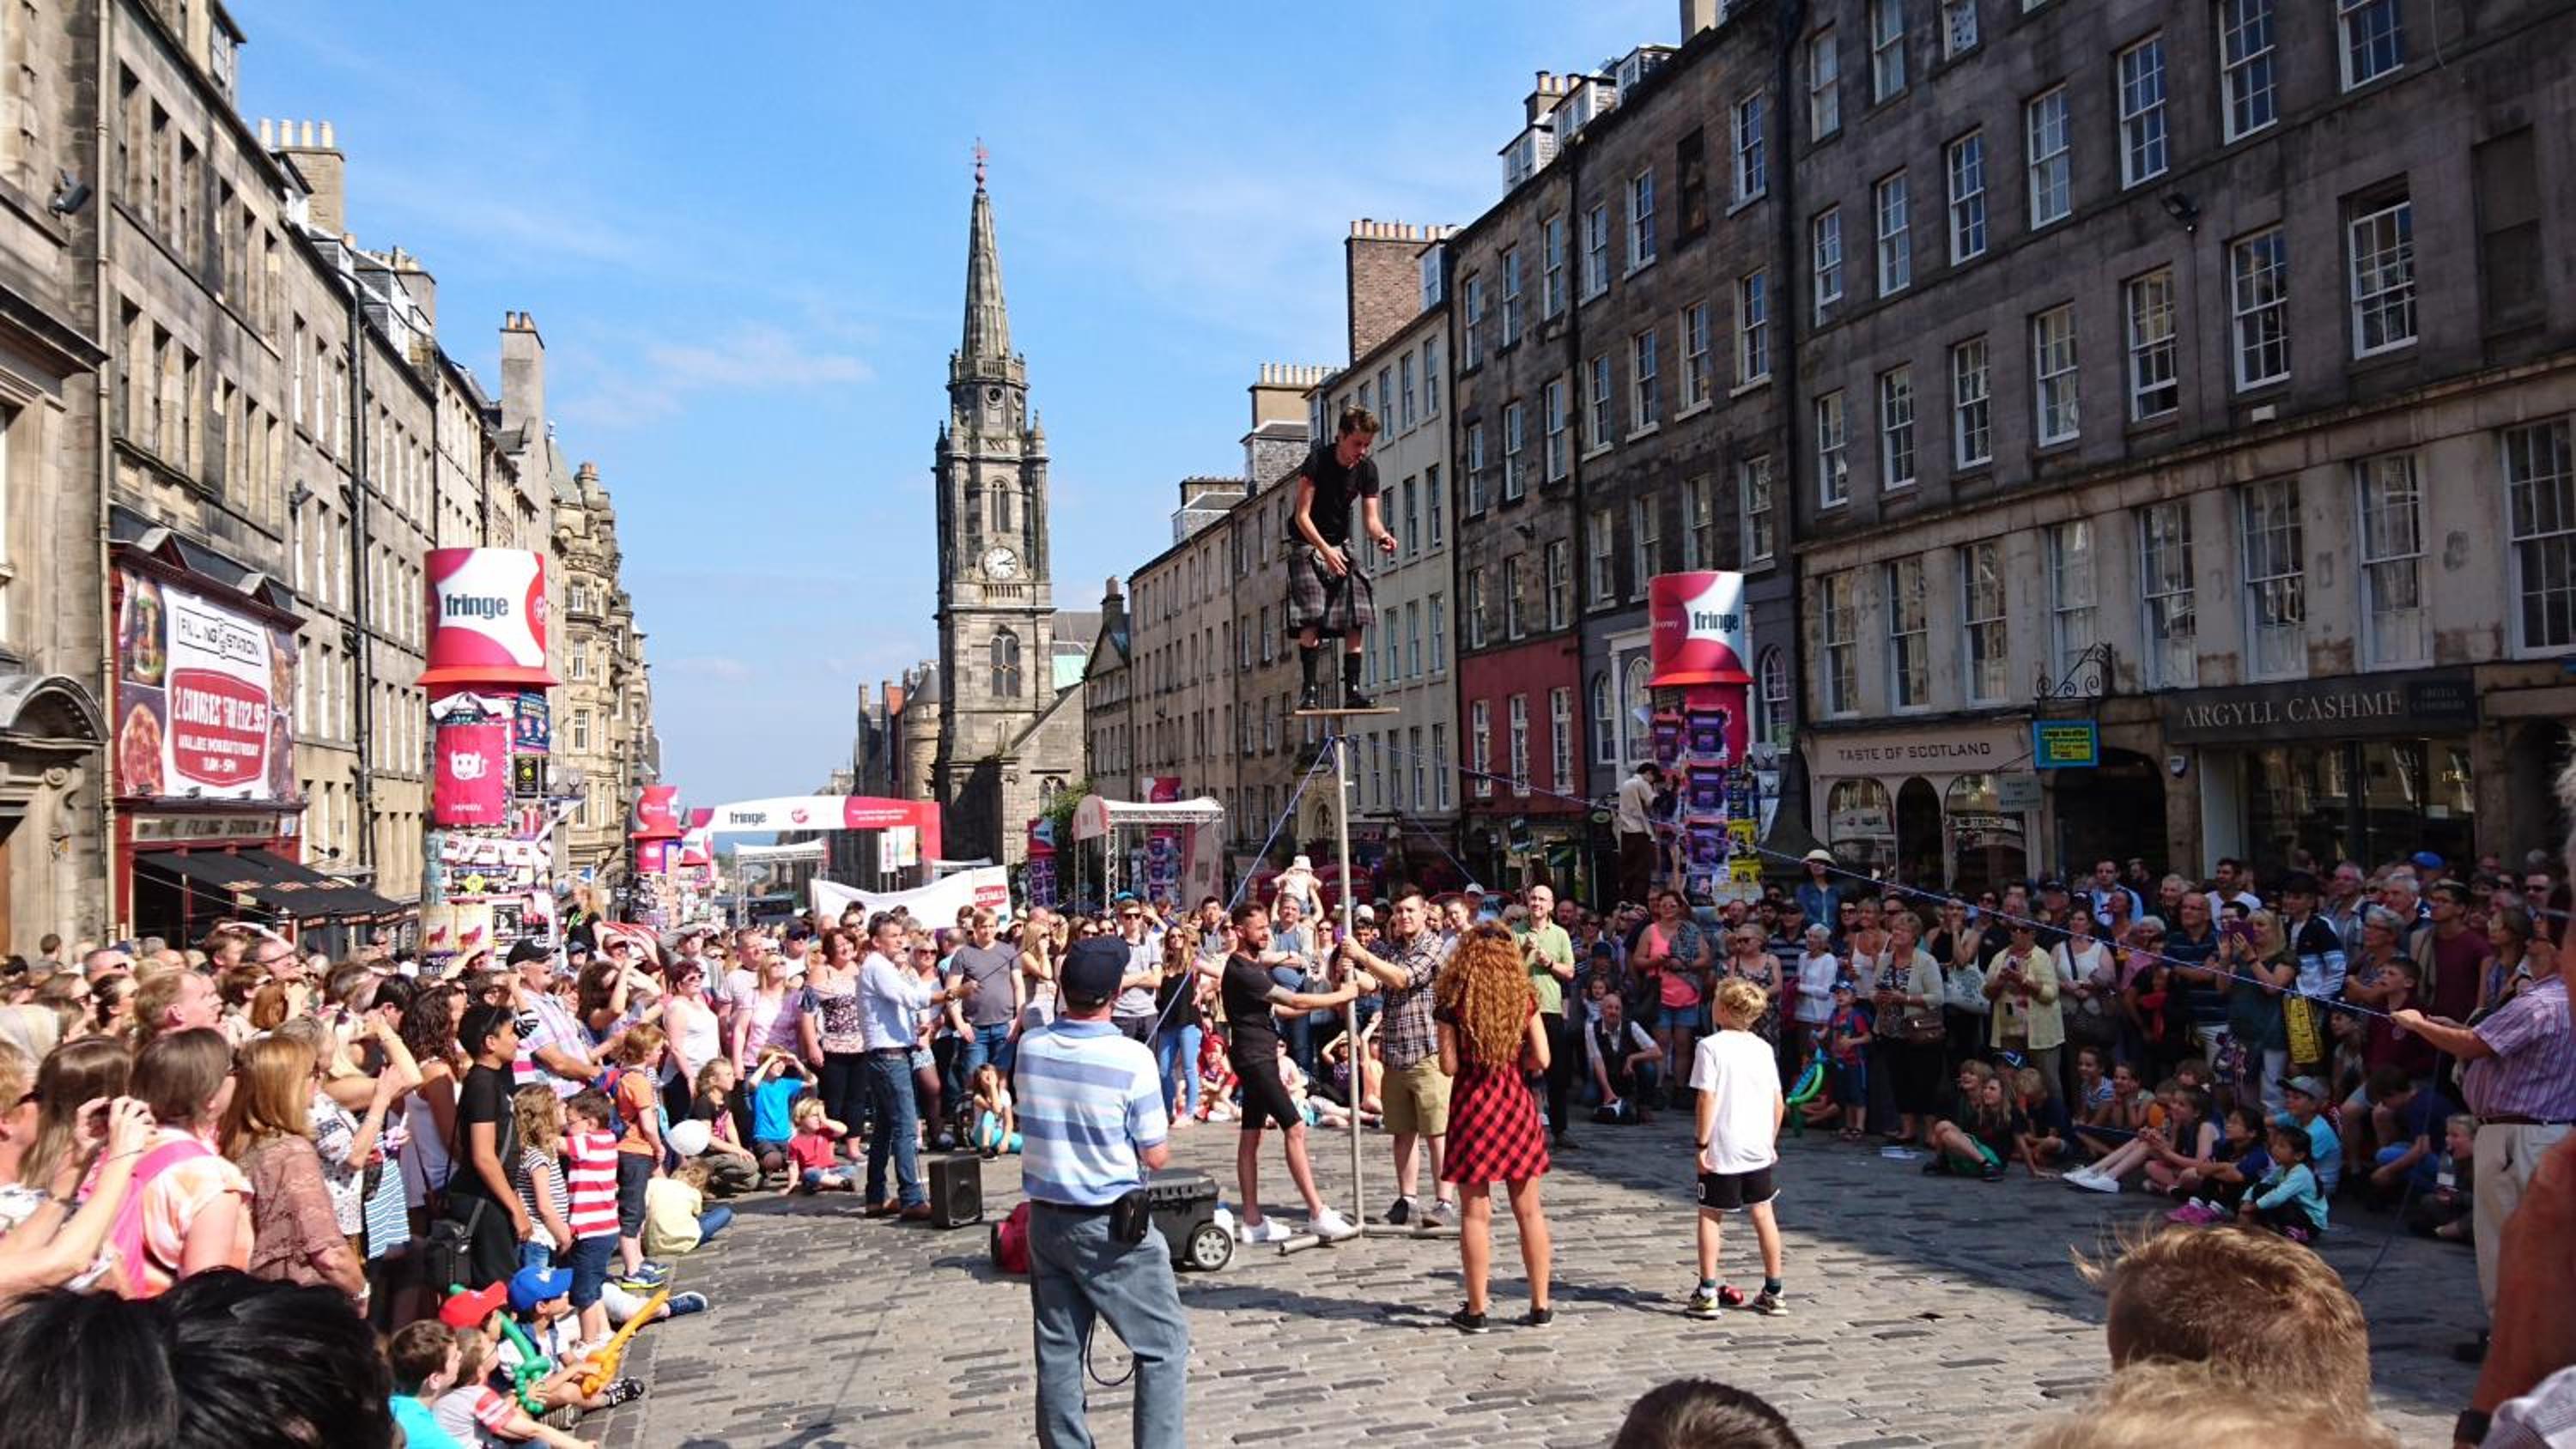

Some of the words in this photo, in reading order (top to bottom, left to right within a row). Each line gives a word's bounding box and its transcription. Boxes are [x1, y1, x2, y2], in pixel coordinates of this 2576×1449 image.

[446, 593, 508, 620] fringe
[1694, 610, 1739, 634] fringe
[174, 686, 183, 720] 2
[2184, 700, 2280, 727] ARGYLL
[1838, 748, 1880, 761] TASTE
[1885, 747, 1904, 760] OF
[1909, 742, 1991, 758] SCOTLAND
[729, 811, 768, 826] fringe
